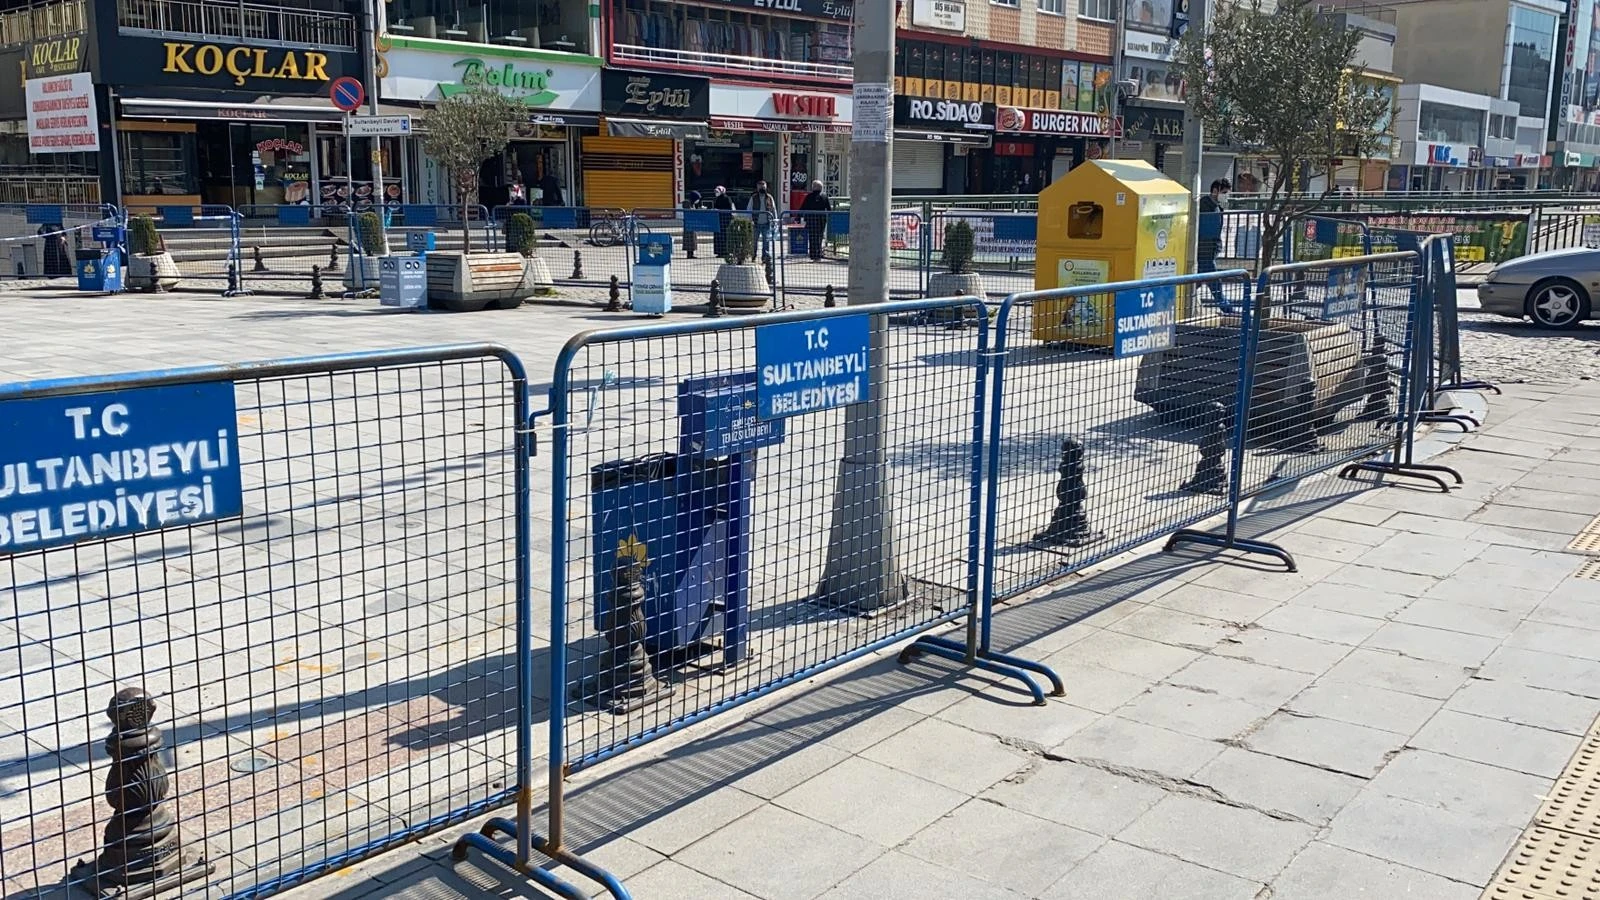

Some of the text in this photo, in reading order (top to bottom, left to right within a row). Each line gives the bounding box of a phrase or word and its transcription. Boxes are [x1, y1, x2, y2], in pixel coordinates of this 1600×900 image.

[33, 39, 80, 69] KOÇLAR
[163, 42, 330, 86] KOÇLAR
[626, 83, 690, 111] Eylül
[772, 93, 839, 117] VESTEL
[648, 125, 672, 136] Eylül
[723, 120, 744, 129] VESTEL
[1033, 113, 1079, 132] BURGER
[256, 139, 303, 156] KOÇLAR
[1140, 292, 1154, 308] T.C
[1118, 306, 1175, 333] SULTANBEYLİ
[1121, 327, 1170, 354] BELEDİYESİ
[763, 346, 867, 386] SULTANBEYLİ
[772, 376, 860, 415] BELEDİYESİ
[65, 404, 129, 439] T.C
